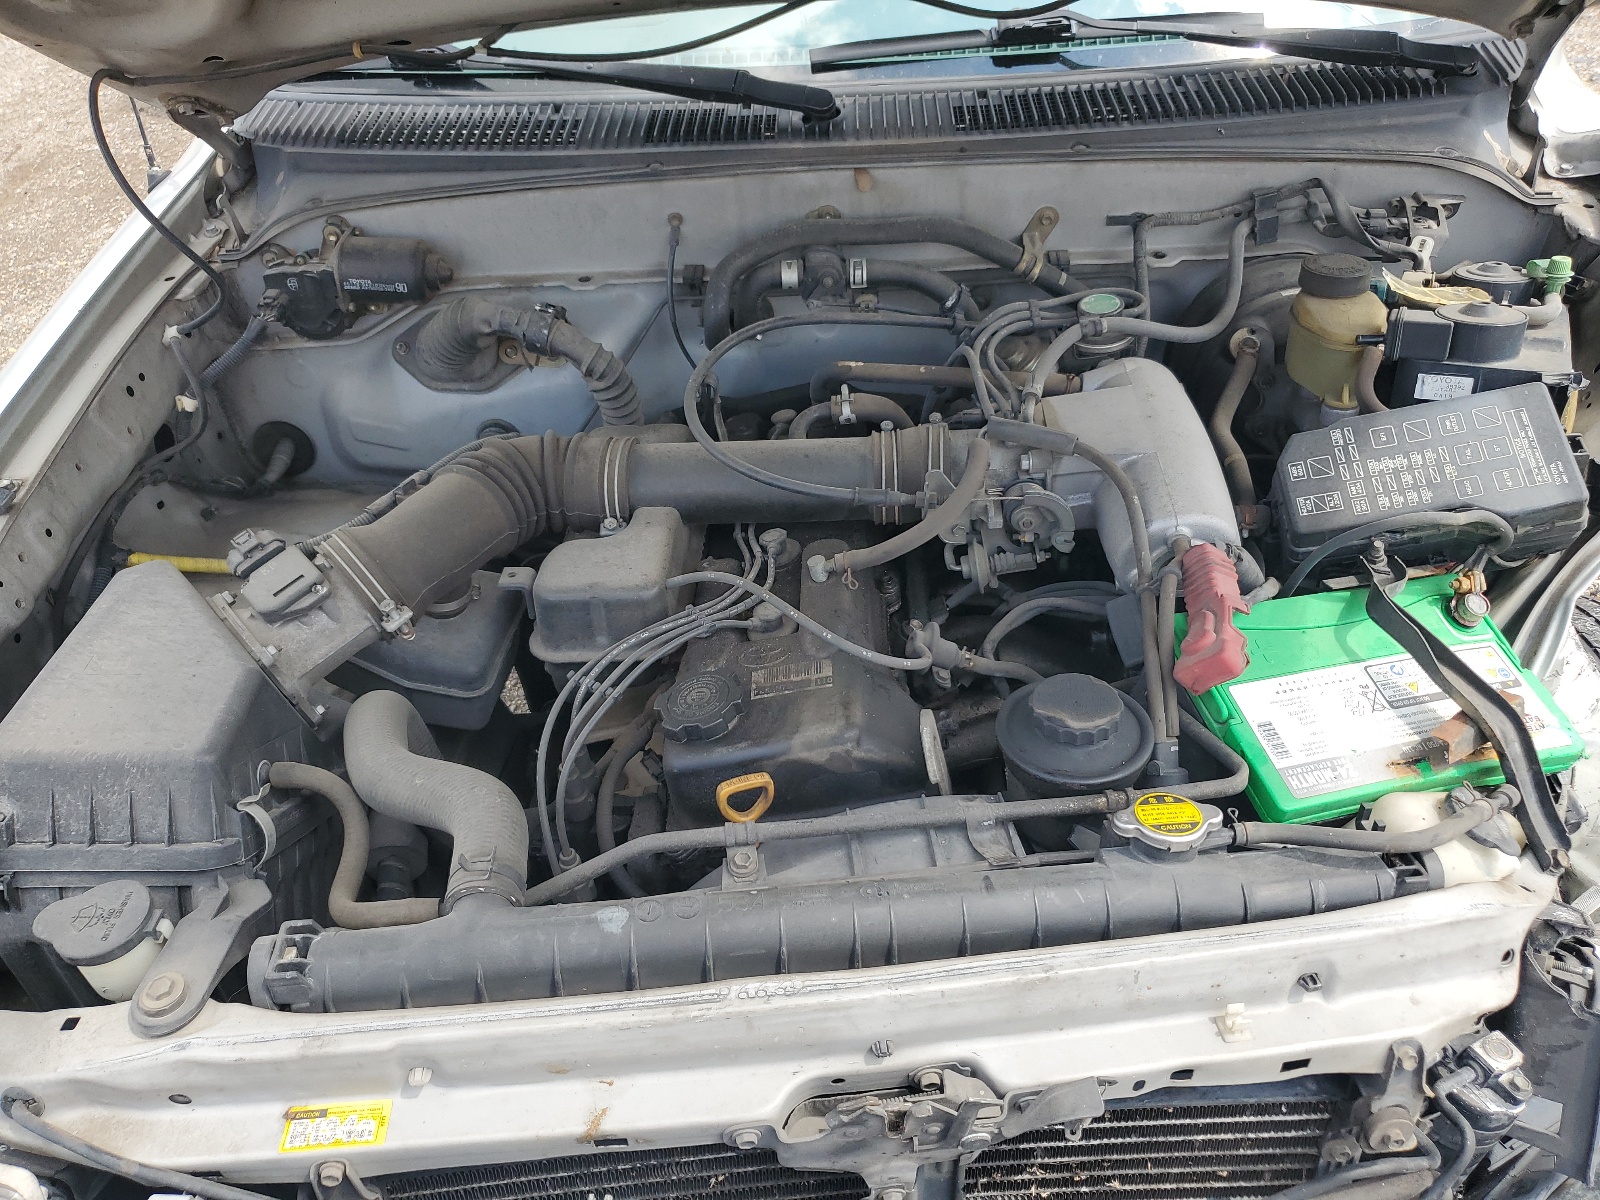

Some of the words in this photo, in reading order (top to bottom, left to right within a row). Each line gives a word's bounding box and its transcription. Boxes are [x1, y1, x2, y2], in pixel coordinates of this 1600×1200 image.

[348, 278, 372, 286] TOYOTA
[395, 282, 408, 293] 90
[1514, 438, 1526, 458] NOTICE
[1503, 471, 1512, 487] HEATER
[1550, 463, 1562, 485] TOYOTA
[1284, 760, 1332, 776] REPLACEMENT
[1287, 765, 1359, 790] 24-MONTH
[112, 891, 133, 919] WASHER
[100, 923, 116, 941] FLUID
[295, 1111, 321, 1119] CAUTION
